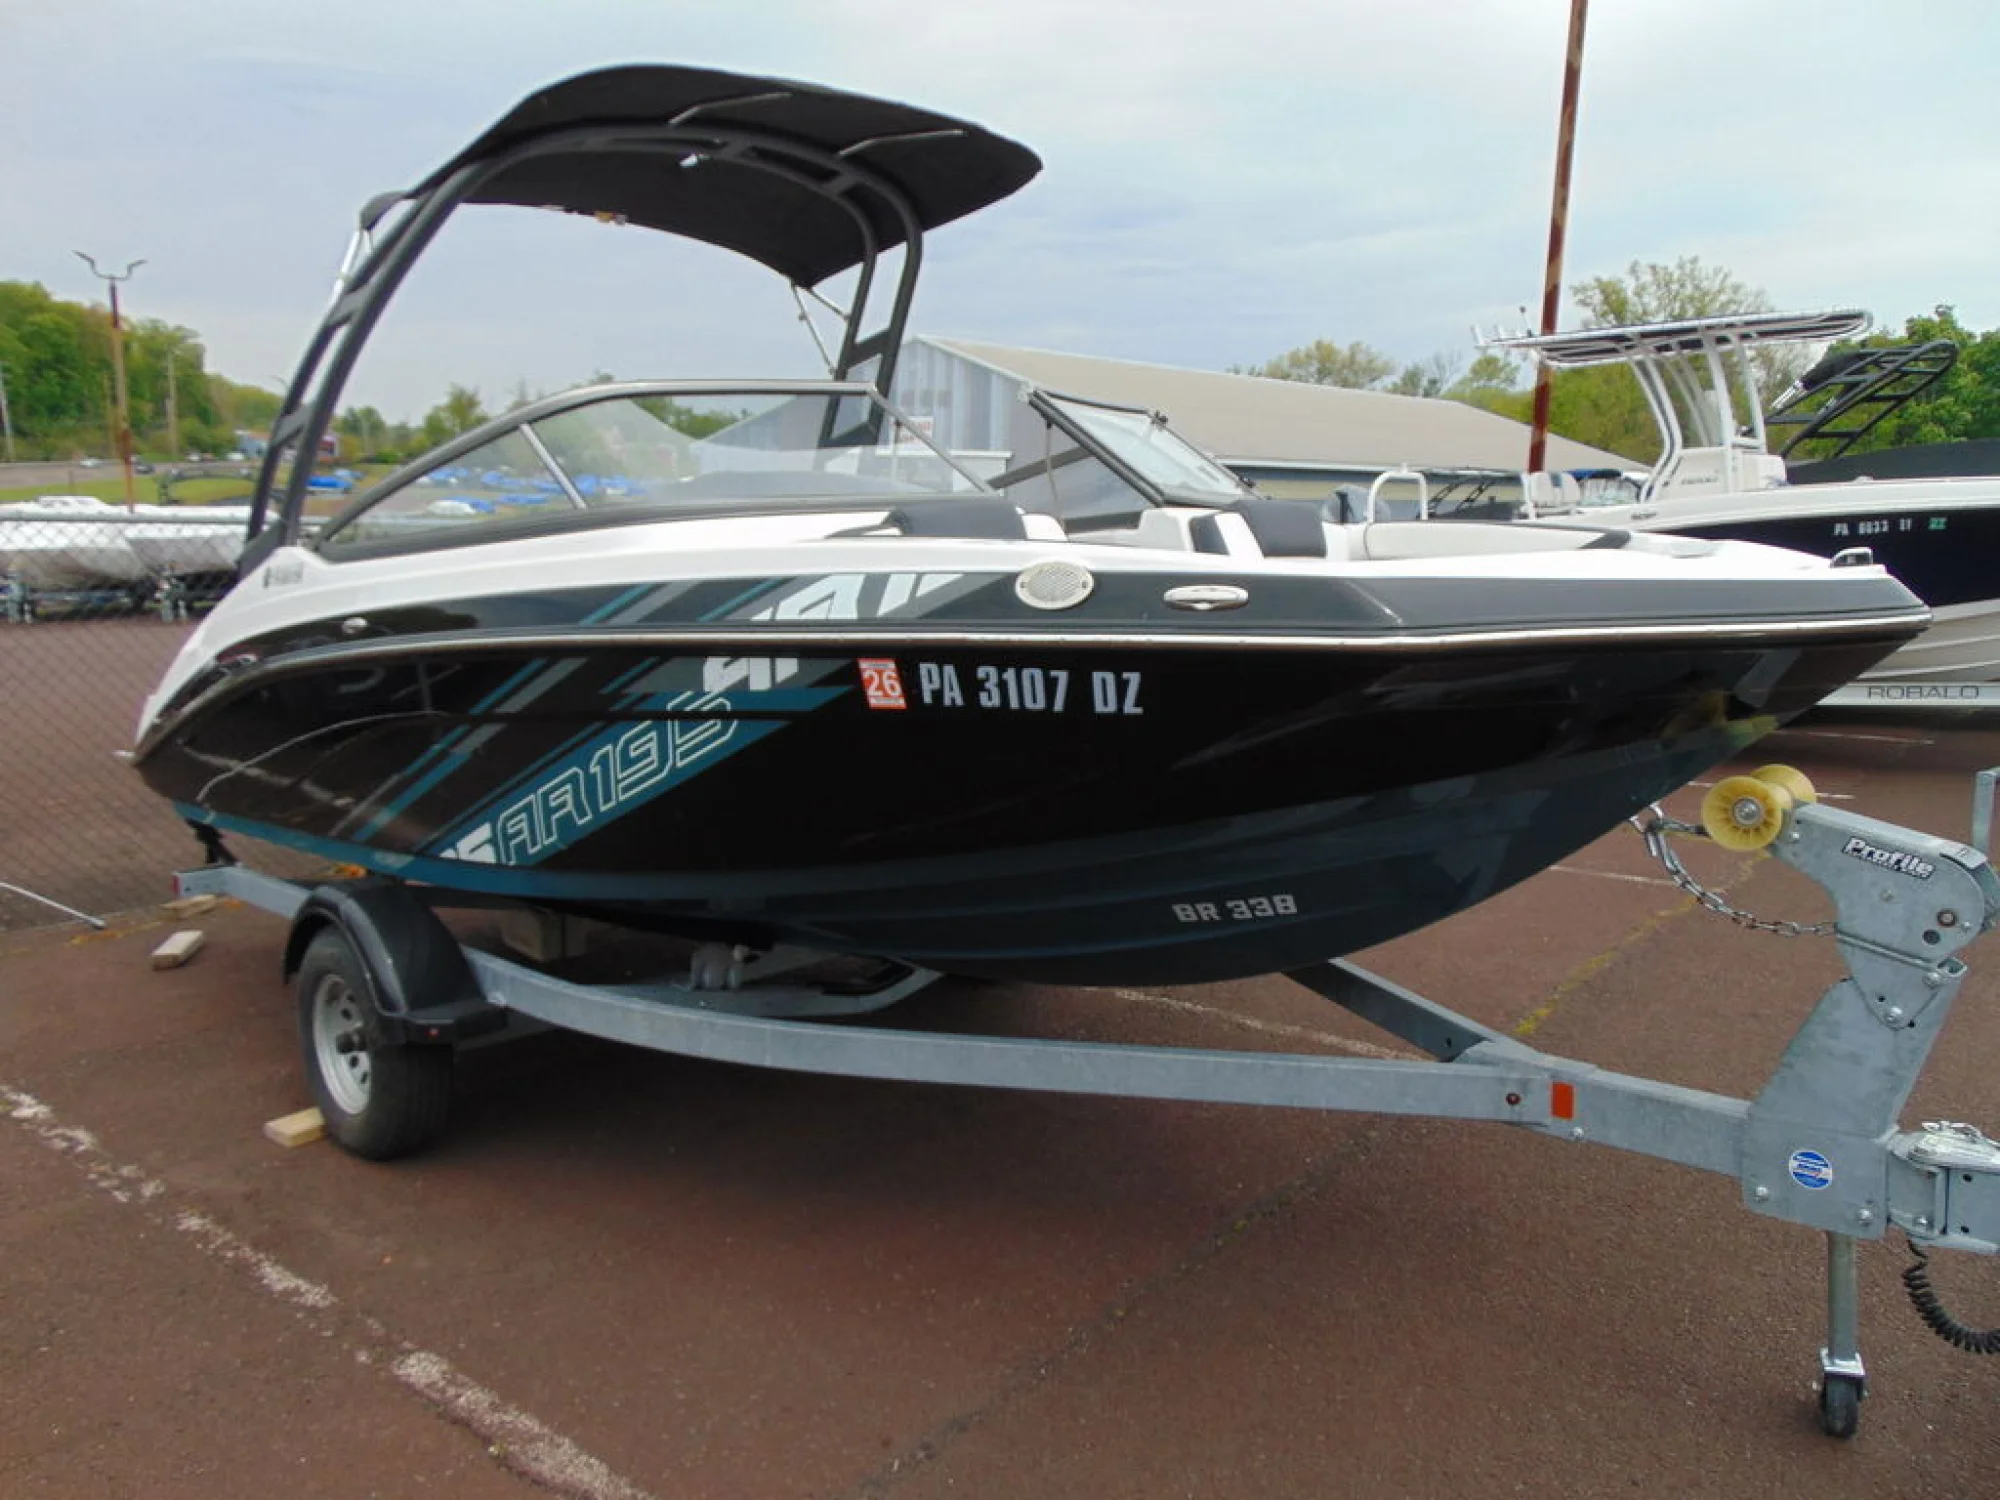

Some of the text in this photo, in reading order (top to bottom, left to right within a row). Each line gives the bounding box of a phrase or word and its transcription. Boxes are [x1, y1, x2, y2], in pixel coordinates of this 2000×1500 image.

[862, 669, 902, 696] 26
[919, 662, 1144, 714] PA 3107 DZ
[1867, 685, 1979, 699] ROBALO
[498, 690, 738, 867] AR195
